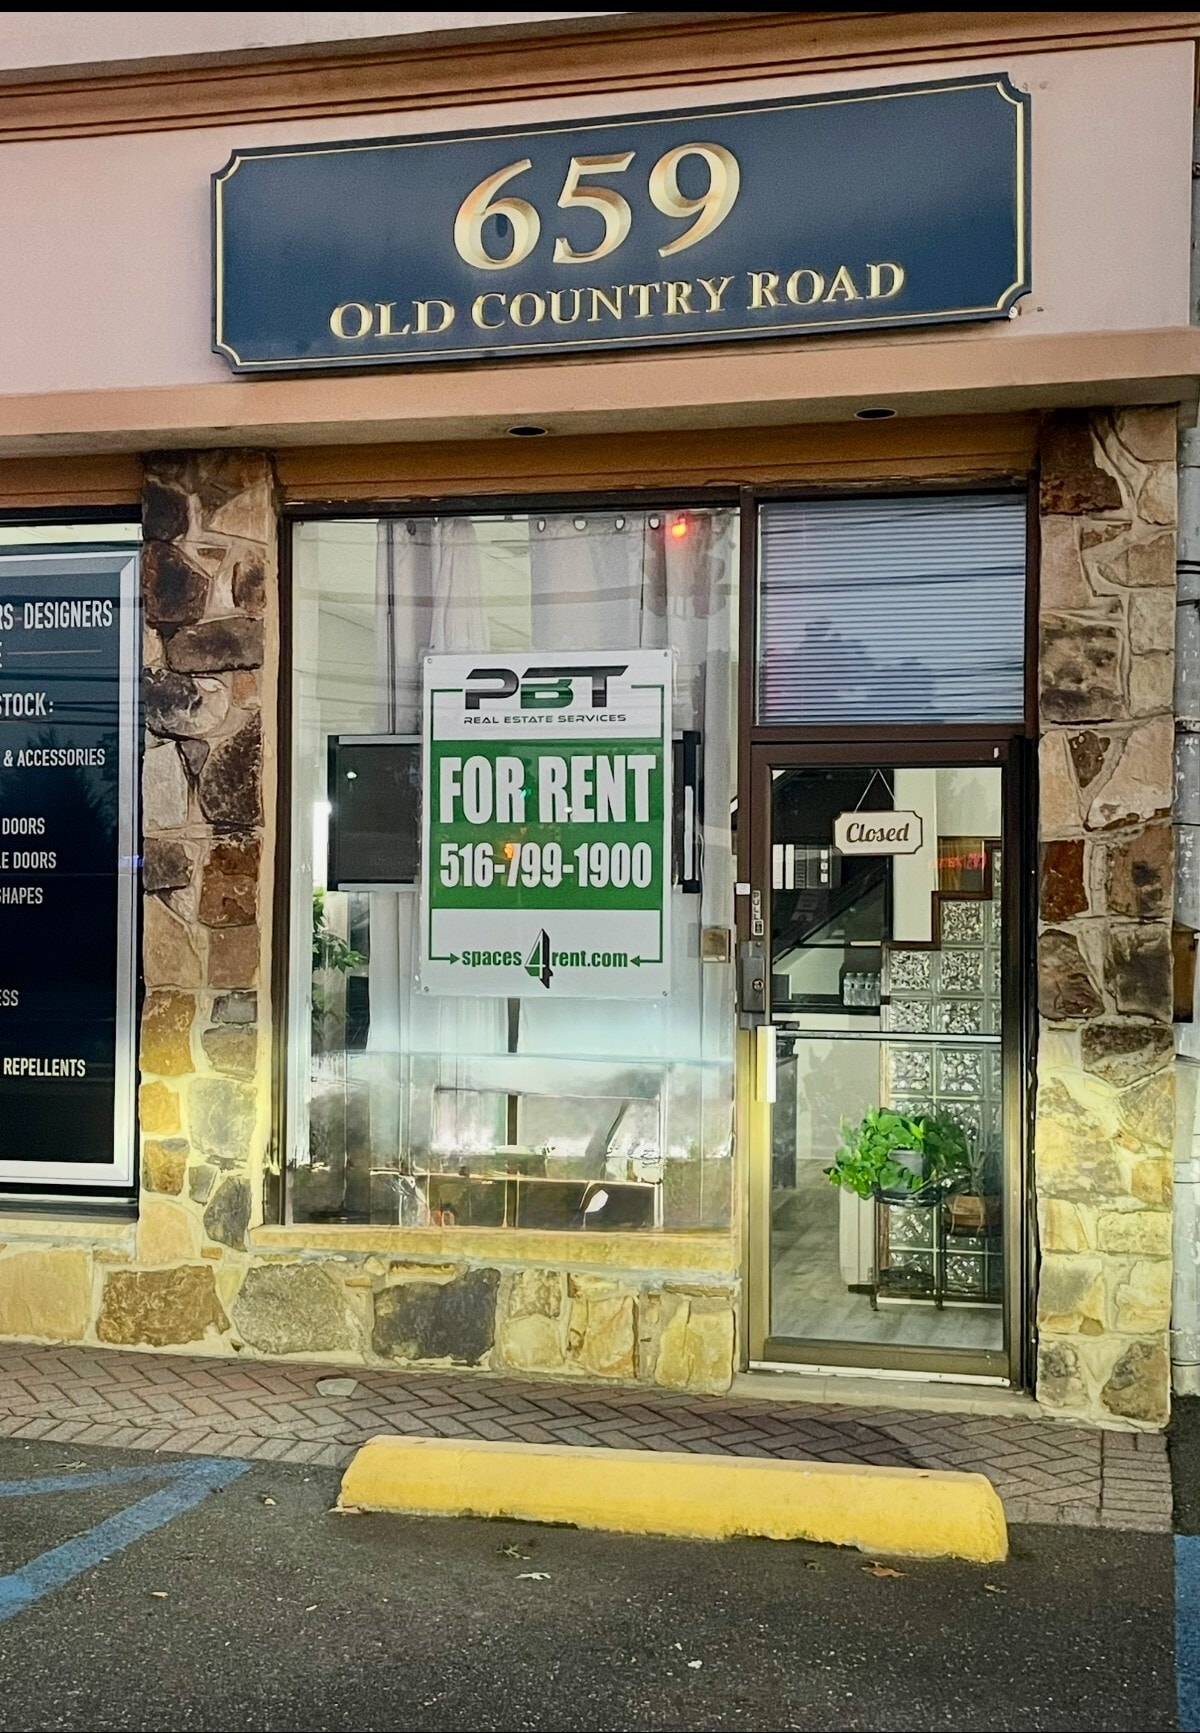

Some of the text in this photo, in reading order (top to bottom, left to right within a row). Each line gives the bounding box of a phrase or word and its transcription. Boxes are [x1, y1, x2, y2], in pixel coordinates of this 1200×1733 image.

[453, 142, 741, 271] 659
[329, 261, 906, 340] OLD COUNTRY ROAD
[24, 600, 113, 629] DESIGNERS
[465, 665, 629, 710] PBT
[0, 692, 54, 717] TOCK:
[464, 714, 627, 724] REAL ESTATE SERVICES
[3, 748, 106, 767] & ACCESSORIES
[439, 754, 657, 824] FOR RENT
[2, 817, 46, 835] DOORS
[846, 822, 909, 843] Closed
[13, 851, 57, 869] DOORS
[439, 841, 652, 889] 516-799-1900
[0, 887, 43, 905] HAPES
[3, 1057, 86, 1077] REPELLENTS
